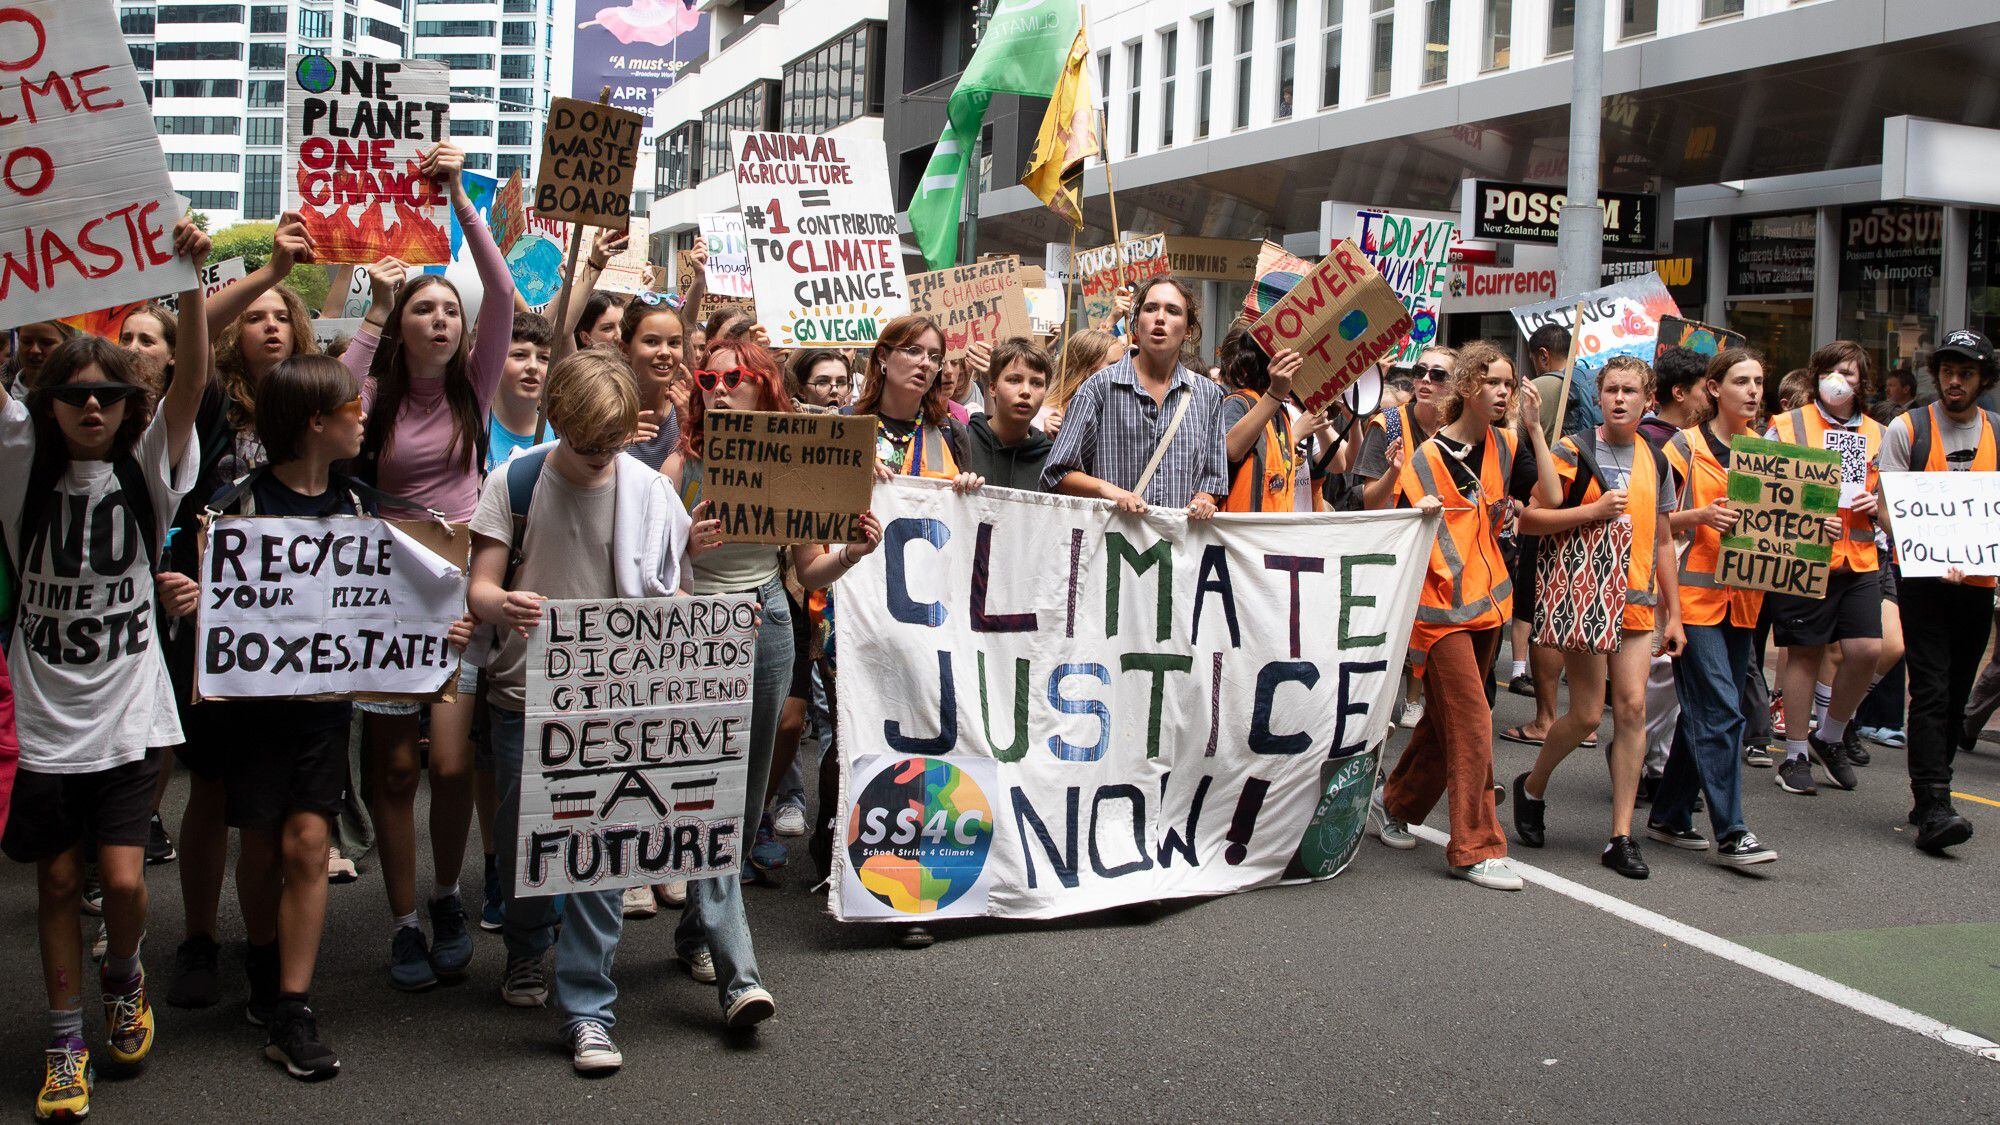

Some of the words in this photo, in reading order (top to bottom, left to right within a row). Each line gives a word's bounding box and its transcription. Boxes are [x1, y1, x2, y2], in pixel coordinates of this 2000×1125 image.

[613, 86, 647, 100] APR
[302, 97, 449, 142] PLANET
[555, 108, 642, 146] DON'T
[300, 137, 395, 170] ONE
[548, 135, 634, 168] WASTE
[741, 134, 845, 163] ANIMAL
[301, 170, 448, 207] CHANCE
[554, 158, 621, 185] CARD
[738, 163, 853, 184] AGRICULTURE
[538, 184, 630, 217] BOARD
[745, 198, 790, 234] #1
[797, 213, 898, 235] CONTRIBUTOR
[1484, 189, 1621, 229] POSSM
[1483, 222, 1503, 234] New
[1504, 223, 1540, 236] Zealand
[751, 238, 784, 263] TO
[787, 239, 895, 273] CLIMATE
[1601, 260, 1653, 276] WESTERN
[794, 271, 901, 308] CHANGE.
[909, 272, 945, 295] THE
[954, 258, 1015, 283] CLIMATE
[1863, 266, 1881, 280] No
[1884, 264, 1934, 282] Imports
[911, 293, 932, 312] IS
[943, 275, 1017, 307] CHANGING.
[1252, 250, 1366, 356] POWER
[794, 319, 816, 341] GO
[819, 316, 878, 341] VEGAN
[944, 311, 1001, 352] WE?
[708, 413, 753, 432] THE
[767, 416, 817, 435] EARTH
[830, 420, 845, 439] IS
[708, 436, 792, 464] GETTING
[801, 446, 862, 468] HOTTER
[708, 467, 762, 489] THAN
[1737, 454, 1790, 479] MAKE
[1794, 459, 1841, 485] LAWS
[1764, 482, 1794, 505] TO
[29, 489, 137, 578] NO
[786, 508, 861, 542] HAWKE
[1731, 508, 1827, 545] PROTECT
[211, 528, 392, 583] RECYCLE
[1757, 538, 1794, 556] OUR
[1902, 538, 1999, 565] POLLUT
[884, 517, 1397, 659] CLIMATE
[1721, 550, 1828, 594] FUTURE
[28, 579, 94, 610] TIME
[106, 577, 135, 607] TO
[210, 585, 294, 609] YOUR
[332, 586, 392, 608] PIZZA
[548, 601, 755, 645] LEONARDO
[546, 640, 753, 680] DICAPRIOS
[551, 679, 748, 711] GIRLFRIEND
[884, 650, 1388, 763] JUSTICE
[540, 717, 743, 768] DESERVE
[860, 806, 984, 845] SS4C
[1009, 773, 1270, 889] NOW!
[526, 822, 738, 885] FUTURE
[863, 848, 895, 857] School
[898, 848, 927, 857] Strike
[930, 848, 936, 857] 4
[939, 848, 975, 857] Climate
